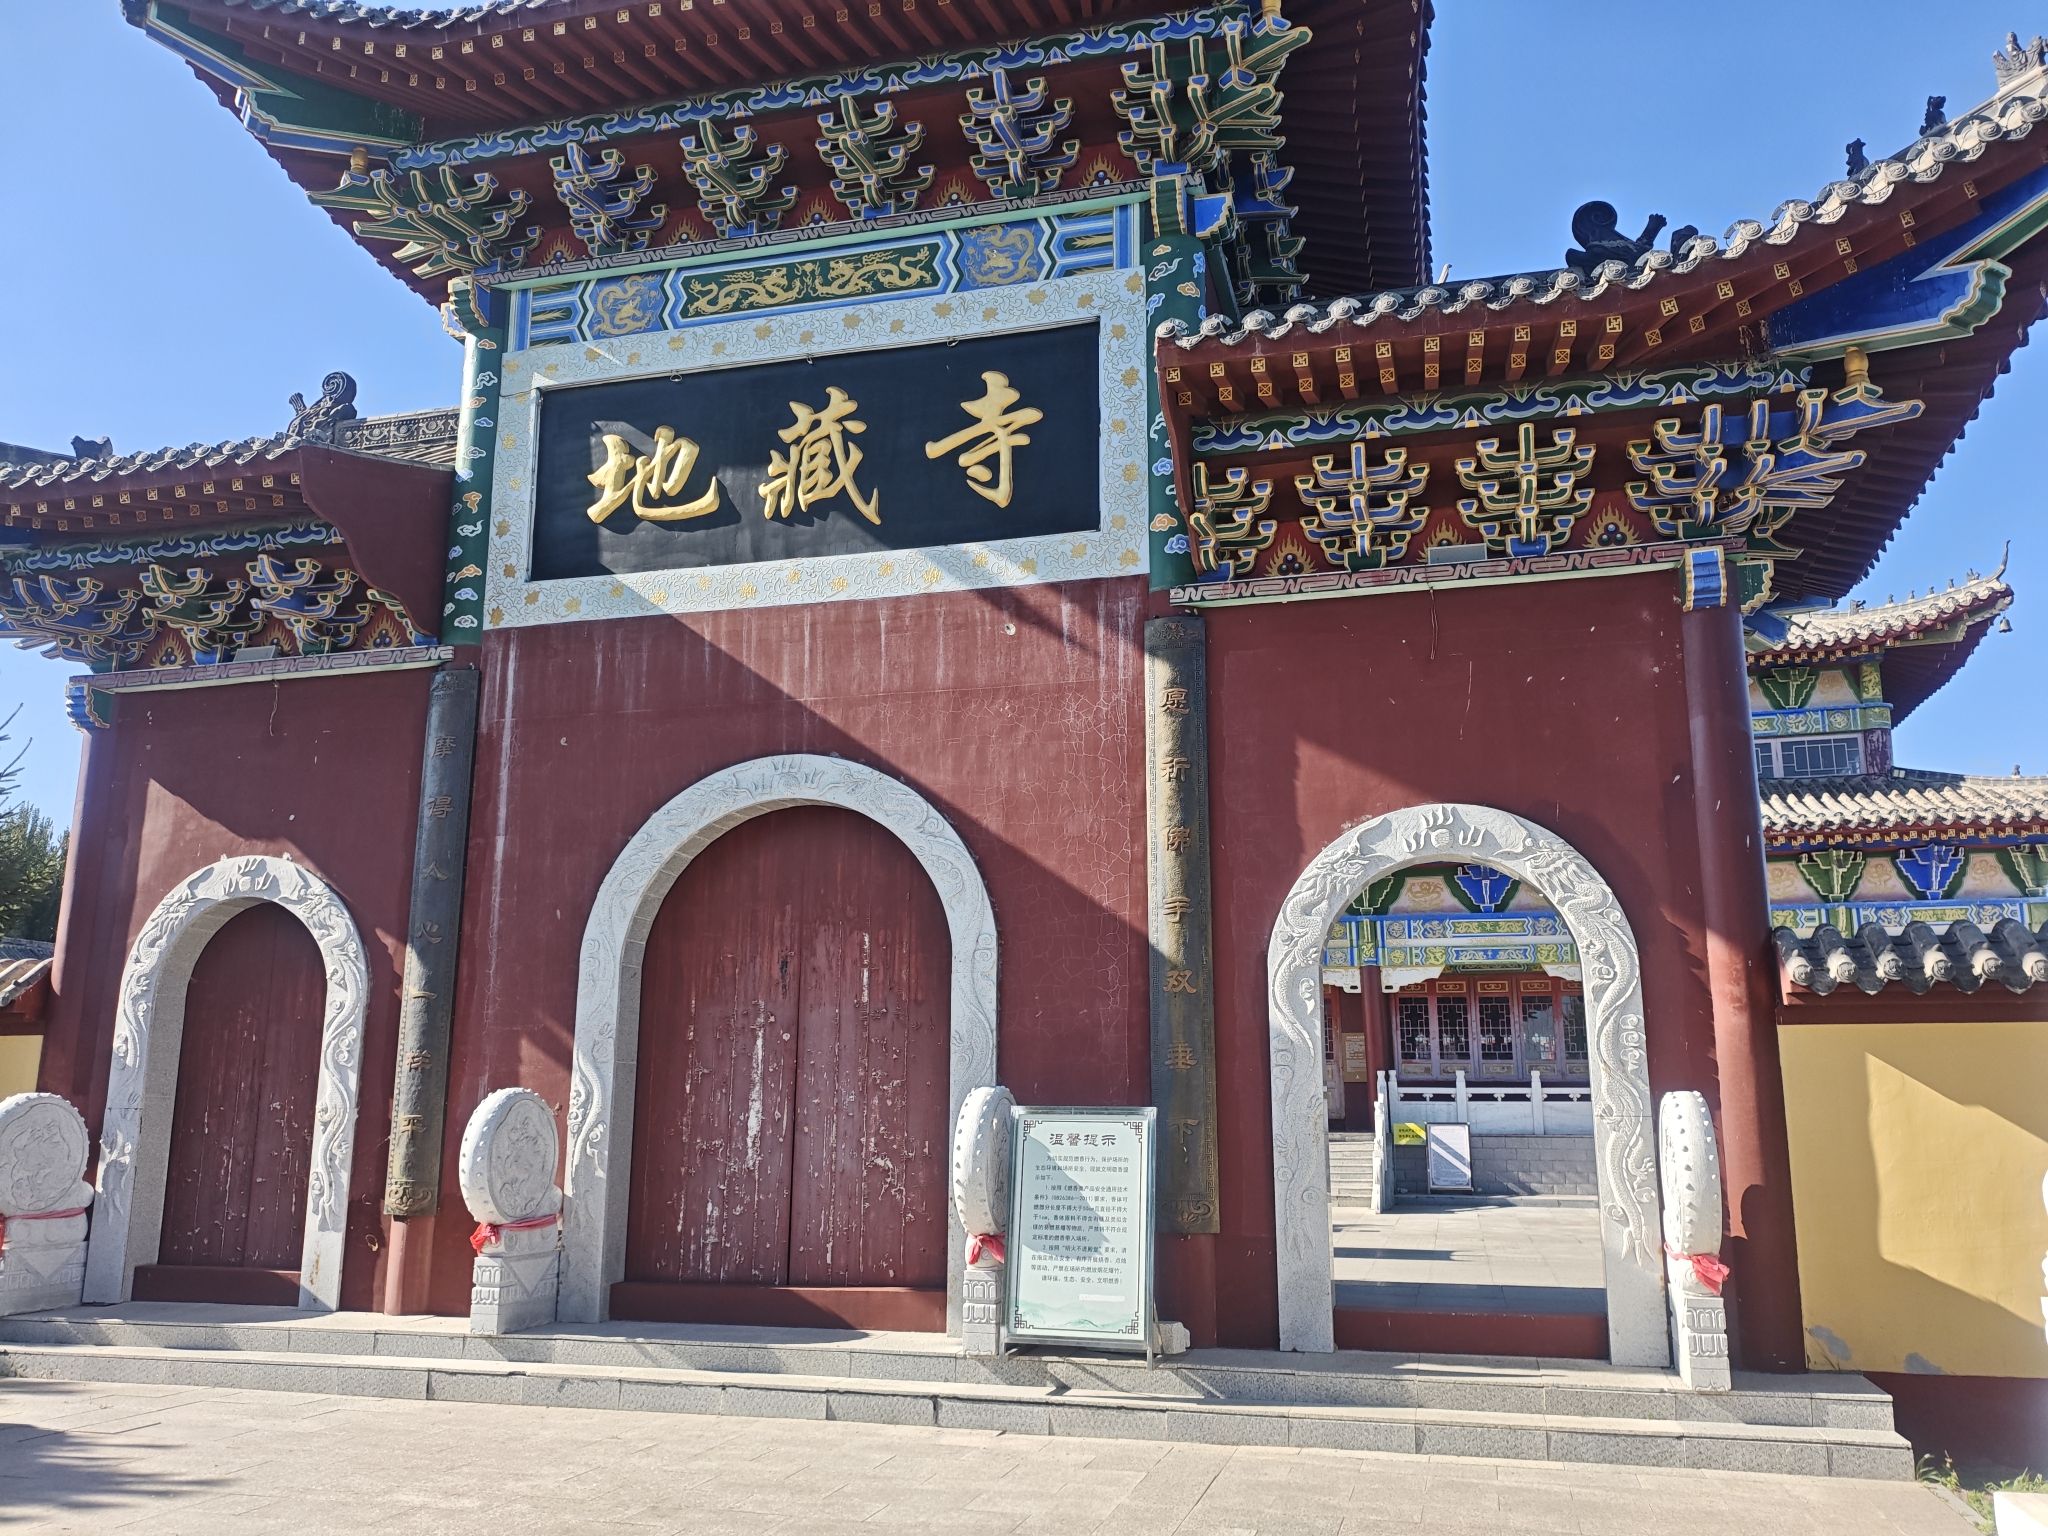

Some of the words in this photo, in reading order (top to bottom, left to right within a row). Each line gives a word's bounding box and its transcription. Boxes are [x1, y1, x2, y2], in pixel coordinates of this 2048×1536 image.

[587, 370, 1044, 525] 地藏寺
[1159, 688, 1199, 1145] 愿祈佛手双垂下
[1049, 1132, 1117, 1147] 温馨提示
